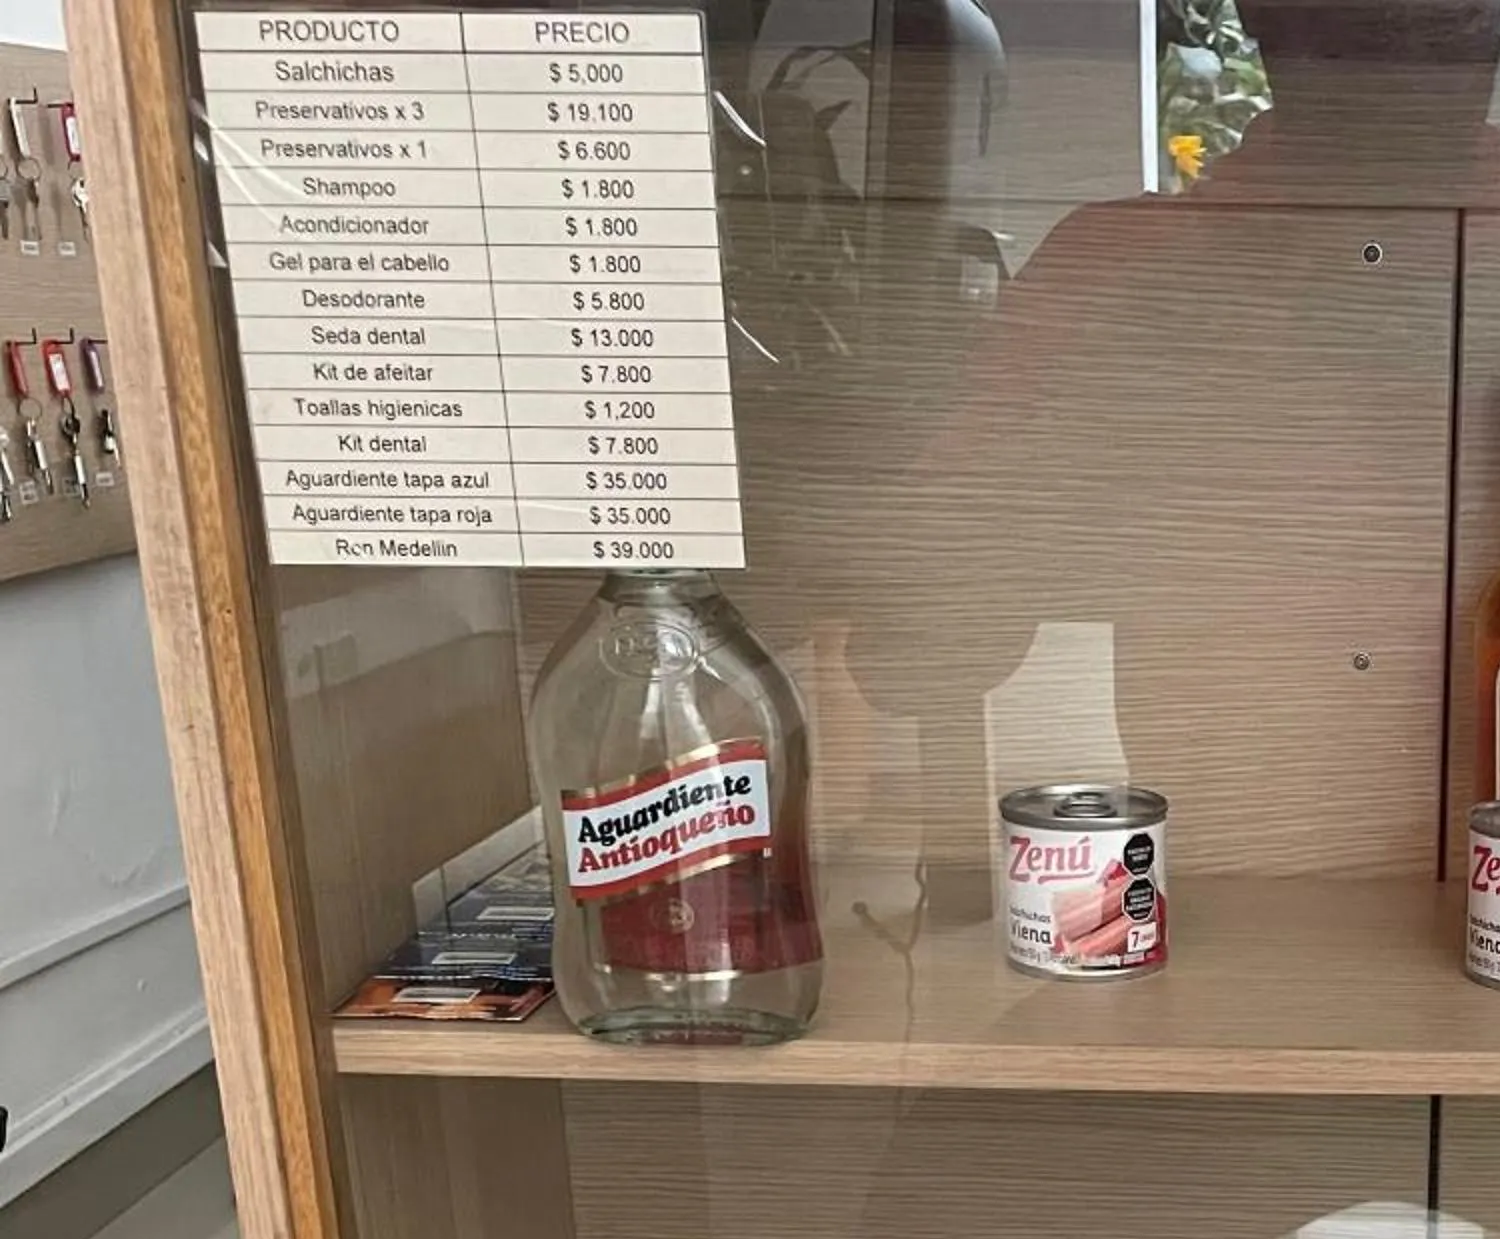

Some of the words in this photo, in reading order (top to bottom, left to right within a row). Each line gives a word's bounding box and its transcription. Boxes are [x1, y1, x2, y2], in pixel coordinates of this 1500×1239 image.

[258, 19, 400, 43] PRODUCTO
[534, 21, 630, 44] PRECIO
[274, 59, 395, 83] Salchichas
[549, 62, 562, 84] $
[255, 100, 389, 121] Preservativos
[394, 106, 407, 121] x
[411, 100, 425, 121] 3
[547, 101, 561, 123] $
[260, 138, 394, 159] Preservativos
[399, 144, 412, 159] x
[417, 139, 427, 159] 1
[557, 140, 571, 161] $
[302, 176, 397, 201] Shampoo
[561, 178, 575, 200] $
[581, 179, 635, 200] 1.800
[279, 214, 430, 236] Acondicionador
[565, 216, 578, 237] $
[585, 217, 638, 237] 1.800
[268, 251, 304, 271] Gel
[308, 255, 353, 274] para
[359, 253, 375, 272] el
[380, 252, 450, 272] cabello
[569, 253, 581, 274] $
[589, 255, 641, 274] 1.800
[301, 288, 425, 309] Desodorante
[572, 290, 585, 311] $
[591, 291, 645, 311] 5.800
[311, 325, 361, 345] Seda
[367, 327, 426, 345] dental
[570, 327, 584, 348] $
[590, 328, 654, 348] 13.000
[312, 363, 339, 381] Kit
[343, 363, 368, 381] de
[373, 363, 433, 382] afeitar
[581, 364, 593, 384] $
[597, 364, 652, 384] 7.800
[293, 397, 363, 417] Toallas
[367, 399, 463, 421] higienicas
[584, 399, 597, 420] $
[337, 434, 364, 453] Kit
[368, 435, 427, 453] dental
[587, 435, 601, 455] $
[605, 436, 659, 455] 7.800
[285, 469, 399, 491] Aguardiente
[403, 471, 445, 492] tapa
[450, 471, 489, 489] azul
[585, 471, 598, 491] $
[603, 471, 668, 491] 35.000
[292, 503, 405, 526] Aguardiente
[409, 506, 452, 527] tapa
[456, 506, 493, 528] roja
[589, 505, 602, 526] $
[607, 506, 671, 525] 35.000
[593, 540, 605, 560] $
[610, 540, 675, 560] 39.000
[578, 774, 752, 847] Aguardiente
[578, 800, 756, 873] Antioqueño
[1008, 835, 1092, 883] Zenú
